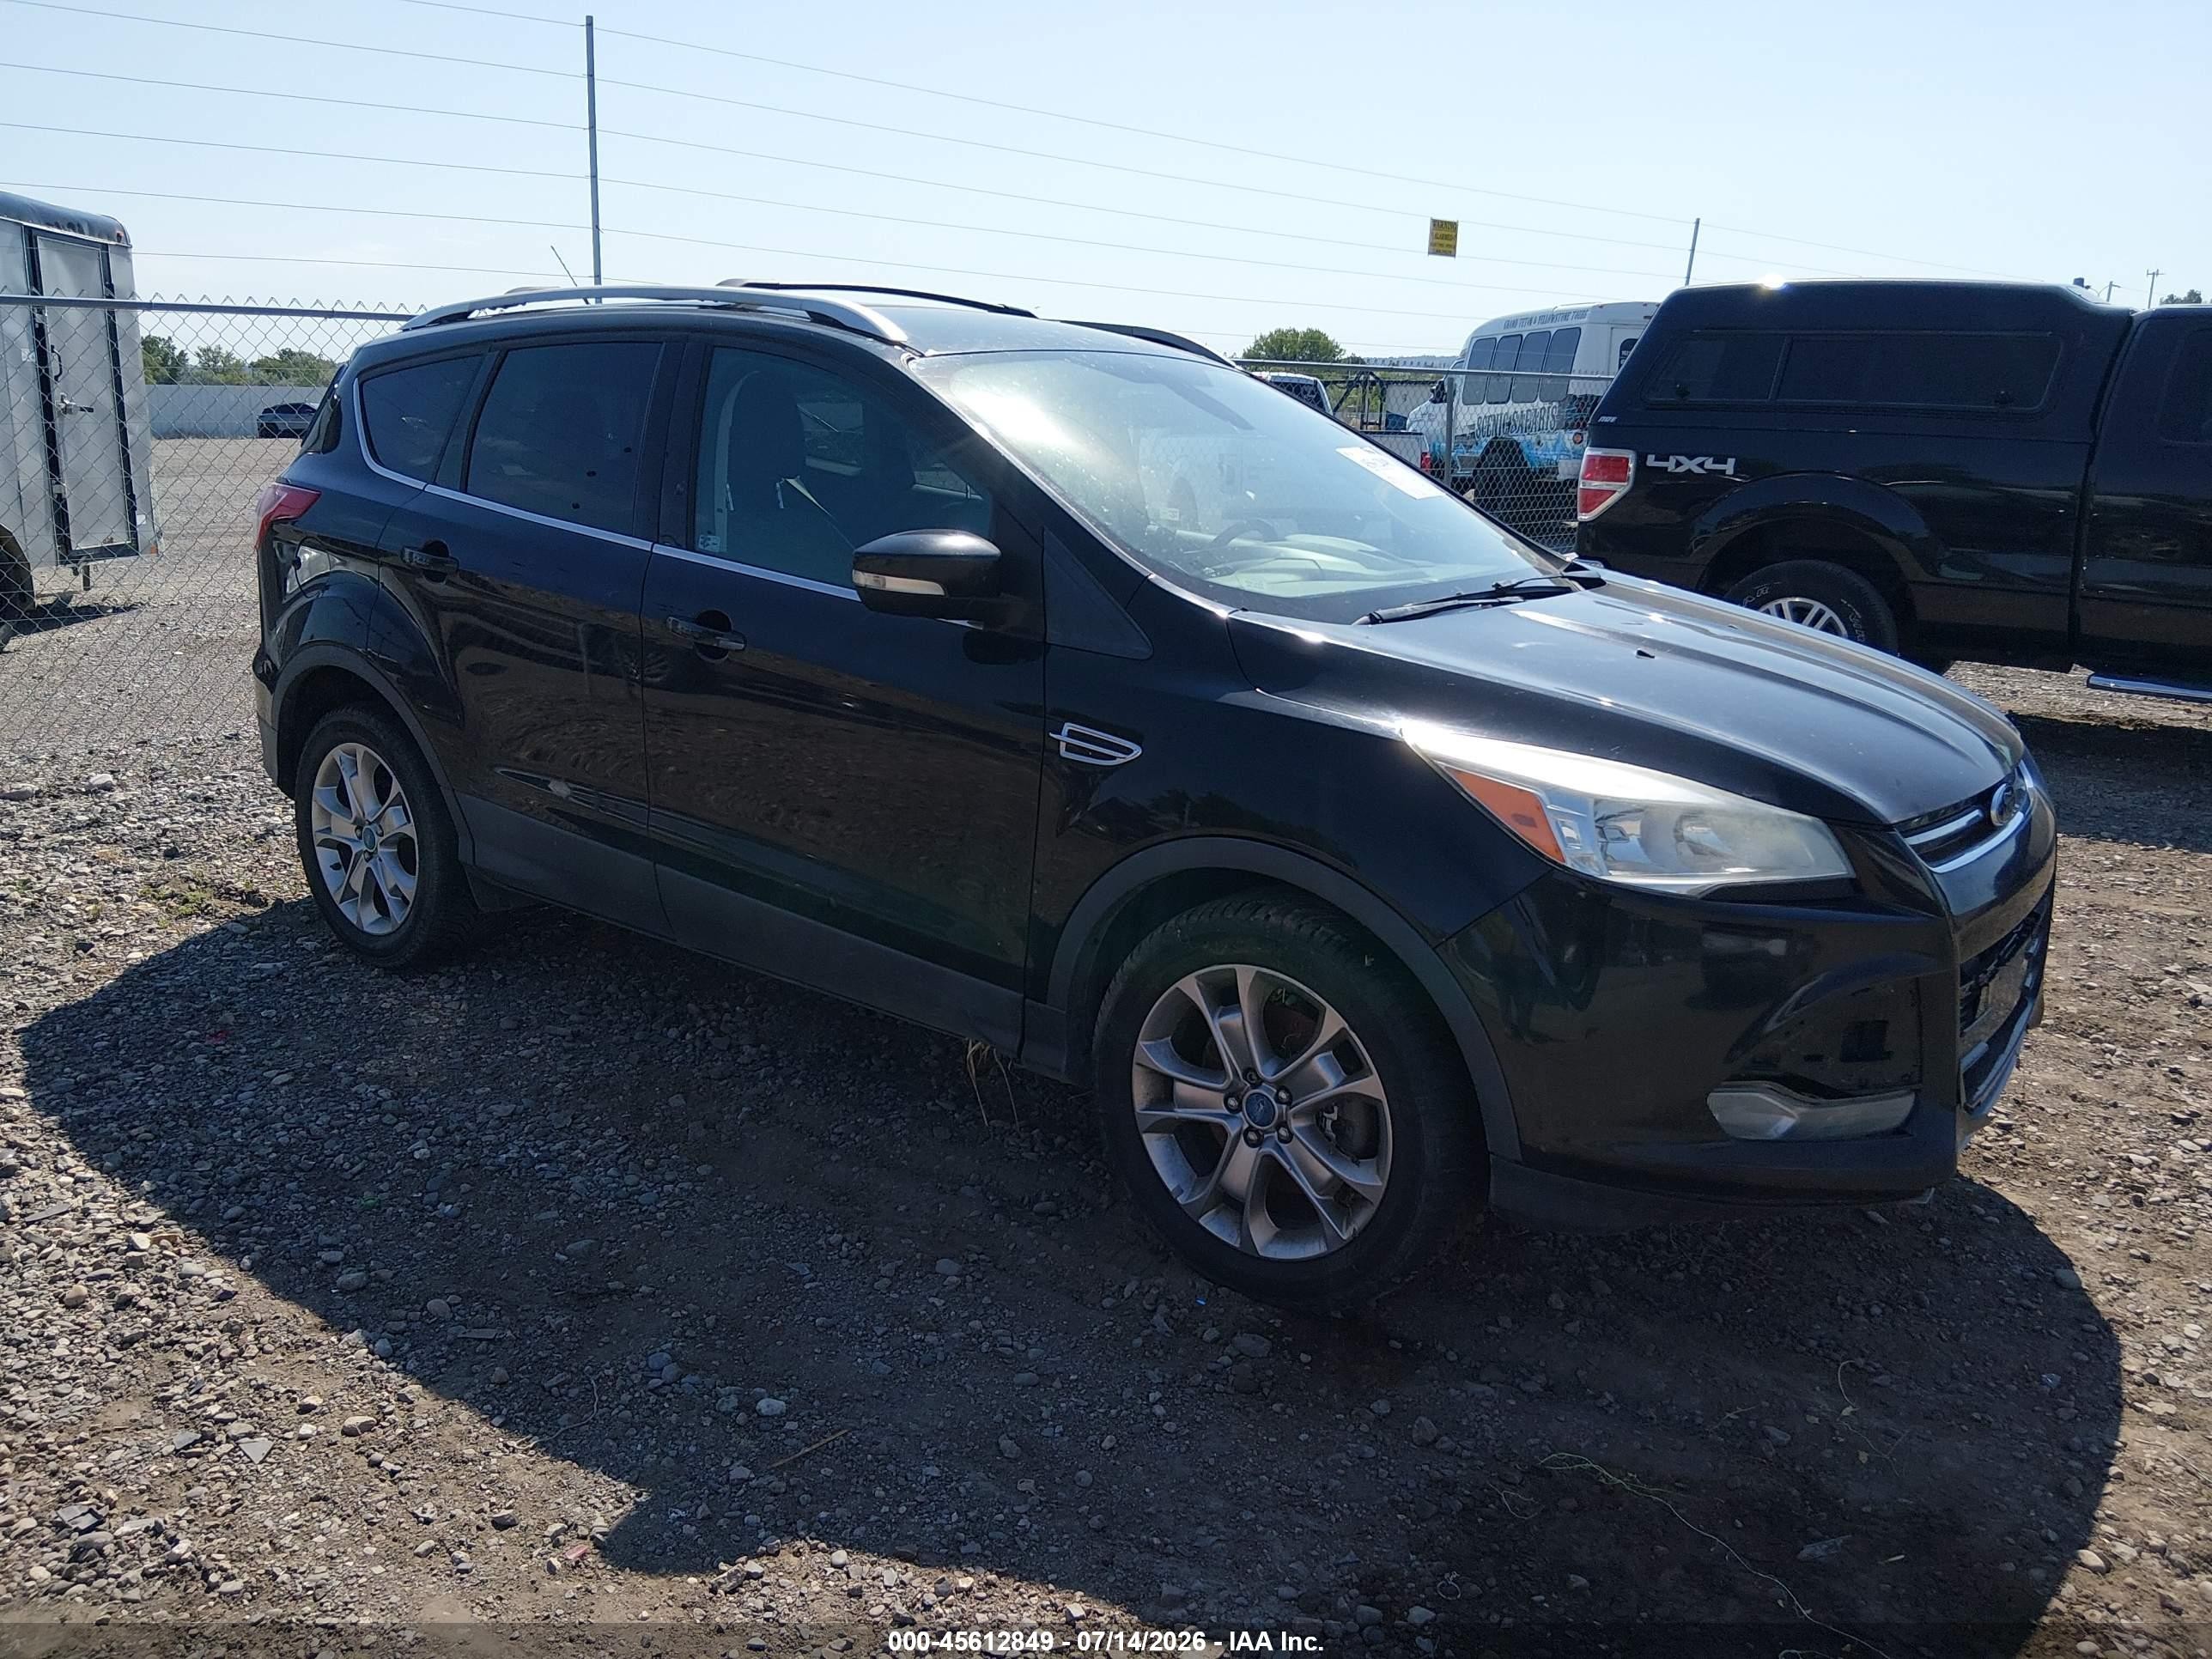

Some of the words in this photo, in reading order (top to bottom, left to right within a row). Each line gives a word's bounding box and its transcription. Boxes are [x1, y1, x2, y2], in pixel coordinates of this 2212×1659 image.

[1475, 412, 1509, 439] SCENIC
[1510, 404, 1558, 434] SAFARIS
[1646, 454, 1735, 475] 4X4
